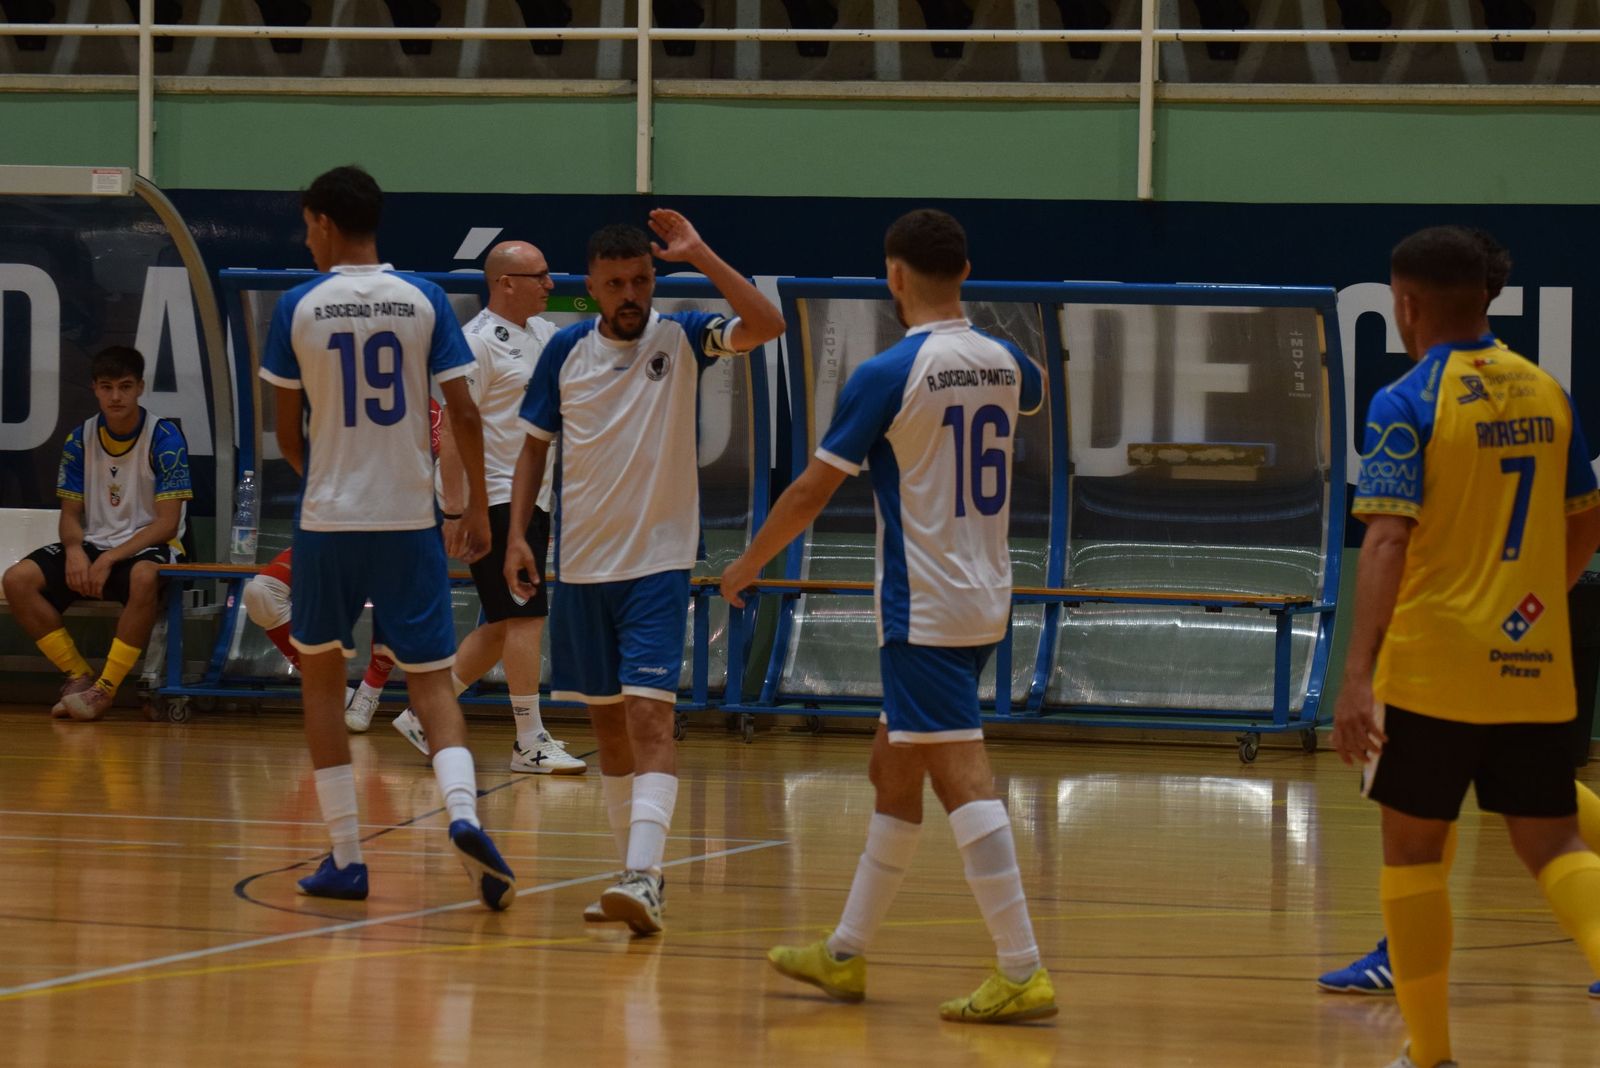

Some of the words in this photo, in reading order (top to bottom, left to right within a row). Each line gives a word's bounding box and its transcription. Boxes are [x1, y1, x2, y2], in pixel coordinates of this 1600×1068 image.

[374, 301, 416, 318] PANTERA
[327, 330, 407, 428] 19
[980, 367, 1016, 386] PANTER
[1062, 280, 1263, 481] DE
[1476, 416, 1555, 449] ANRESITO
[942, 404, 1010, 519] 16
[1501, 456, 1537, 561] 7
[1489, 648, 1554, 663] Domino's
[1500, 664, 1541, 678] Pizza
